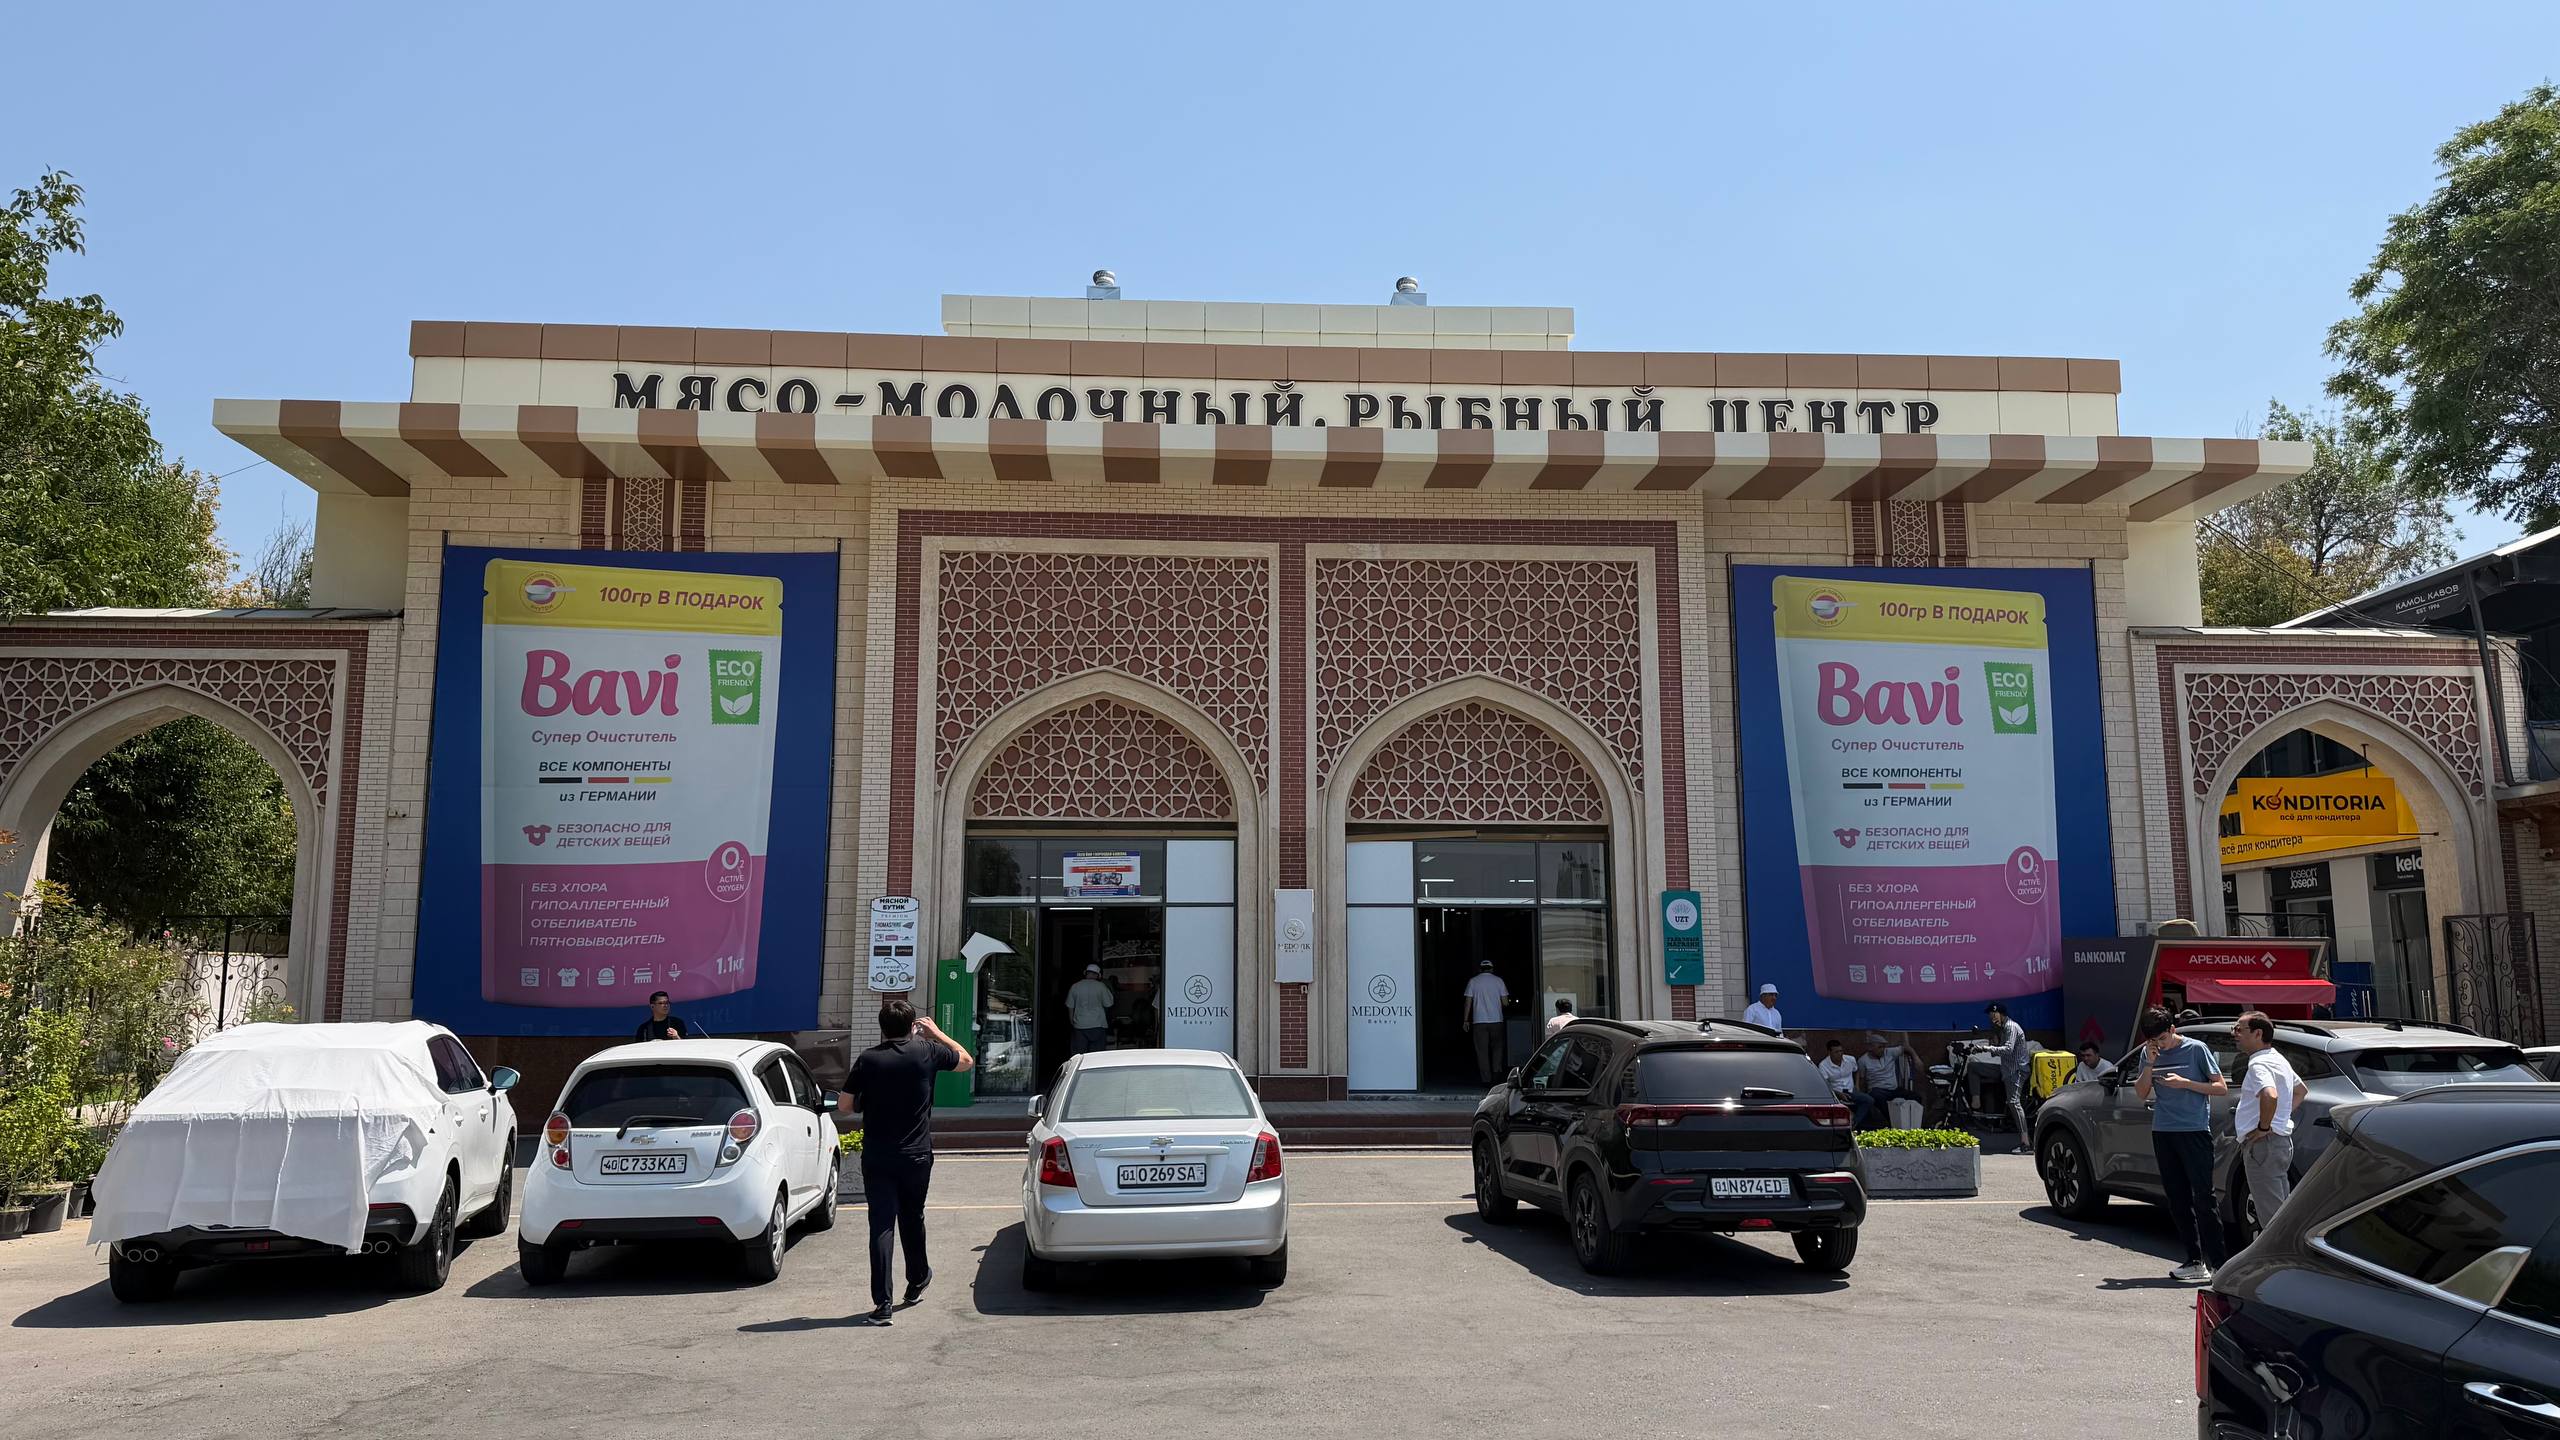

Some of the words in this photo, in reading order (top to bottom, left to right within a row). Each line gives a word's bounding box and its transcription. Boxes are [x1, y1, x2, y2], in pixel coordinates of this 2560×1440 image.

[1344, 385, 1664, 432] РЫБНЫЙ
[1707, 399, 1940, 435] ЦЕНТР
[599, 587, 652, 607] 100гр
[658, 590, 670, 605] В
[675, 591, 764, 610] ПОДАРОК
[2395, 596, 2426, 611] KAMOL
[2427, 584, 2459, 600] KABOB
[1879, 602, 1928, 621] 100гр
[1932, 605, 1944, 619] В
[1948, 606, 2029, 625] ПОДАРОК
[716, 660, 755, 676] ECO
[520, 649, 682, 717] Bavi
[717, 679, 754, 687] FRIENDLY
[1992, 672, 2028, 688] ECO
[1817, 661, 1964, 726] Bavi
[1995, 690, 2027, 698] FRIENDLY
[531, 730, 582, 746] Супер
[586, 731, 677, 744] Очиститель
[1831, 738, 1878, 753] Супер
[1882, 739, 1965, 751] Очиститель
[539, 761, 568, 772] ВСЕ
[572, 760, 671, 772] КОМПОНЕНТЫ
[1842, 768, 1868, 779] ВСЕ
[1873, 768, 1962, 779] КОМПОНЕНТЫ
[579, 790, 657, 802] ГЕРМАНИИ
[1882, 796, 1952, 807] ГЕРМАНИИ
[2280, 813, 2295, 821] всё
[2315, 814, 2361, 822] кондитера
[556, 822, 641, 834] БЕЗОПАСНО
[643, 822, 672, 833] ДЛЯ
[1865, 827, 1941, 837] БЕЗОПАСНО
[1944, 827, 1969, 838] ДЛЯ
[556, 836, 620, 848] ДЕТСКИХ
[623, 834, 671, 847] ВЕЩЕЙ
[1866, 840, 1925, 851] ДЕТСКИХ
[1928, 838, 1970, 850] ВЕЩЕЙ
[2221, 843, 2236, 856] всё
[2237, 842, 2253, 855] для
[2255, 835, 2303, 851] кондитера
[719, 875, 745, 884] ACTIVE
[2018, 879, 2041, 887] ACTIVE
[531, 882, 557, 893] БЕЗ
[560, 882, 608, 893] ХЛОРА
[717, 884, 745, 893] OXYGEN
[1849, 883, 1872, 893] БЕЗ
[1876, 884, 1919, 893] ХЛОРА
[2017, 887, 2042, 896] OXYGEN
[530, 896, 670, 911] ГИПОАЛЛЕРГЕННЫЙ
[1850, 898, 1976, 911] ГИПОАЛЛЕРГЕННЫЙ
[531, 917, 638, 929] ОТБЕЛИВАТЕЛЬ
[1852, 917, 1949, 928] ОТБЕЛИВАТЕЛЬ
[529, 934, 665, 948] ПЯТНОВЫВОДИТЕЛЬ
[1853, 933, 1977, 946] ПЯТНОВЫВОДИТЕЛЬ
[2074, 951, 2126, 964] BANKOMAT
[2188, 954, 2257, 965] APEXBANK
[1167, 1006, 1230, 1018] MEDOVIK
[1351, 1005, 1413, 1017] MEDOVIK
[604, 1159, 618, 1171] 40
[1123, 1169, 1136, 1182] 01
[1715, 1181, 1728, 1192] 01
